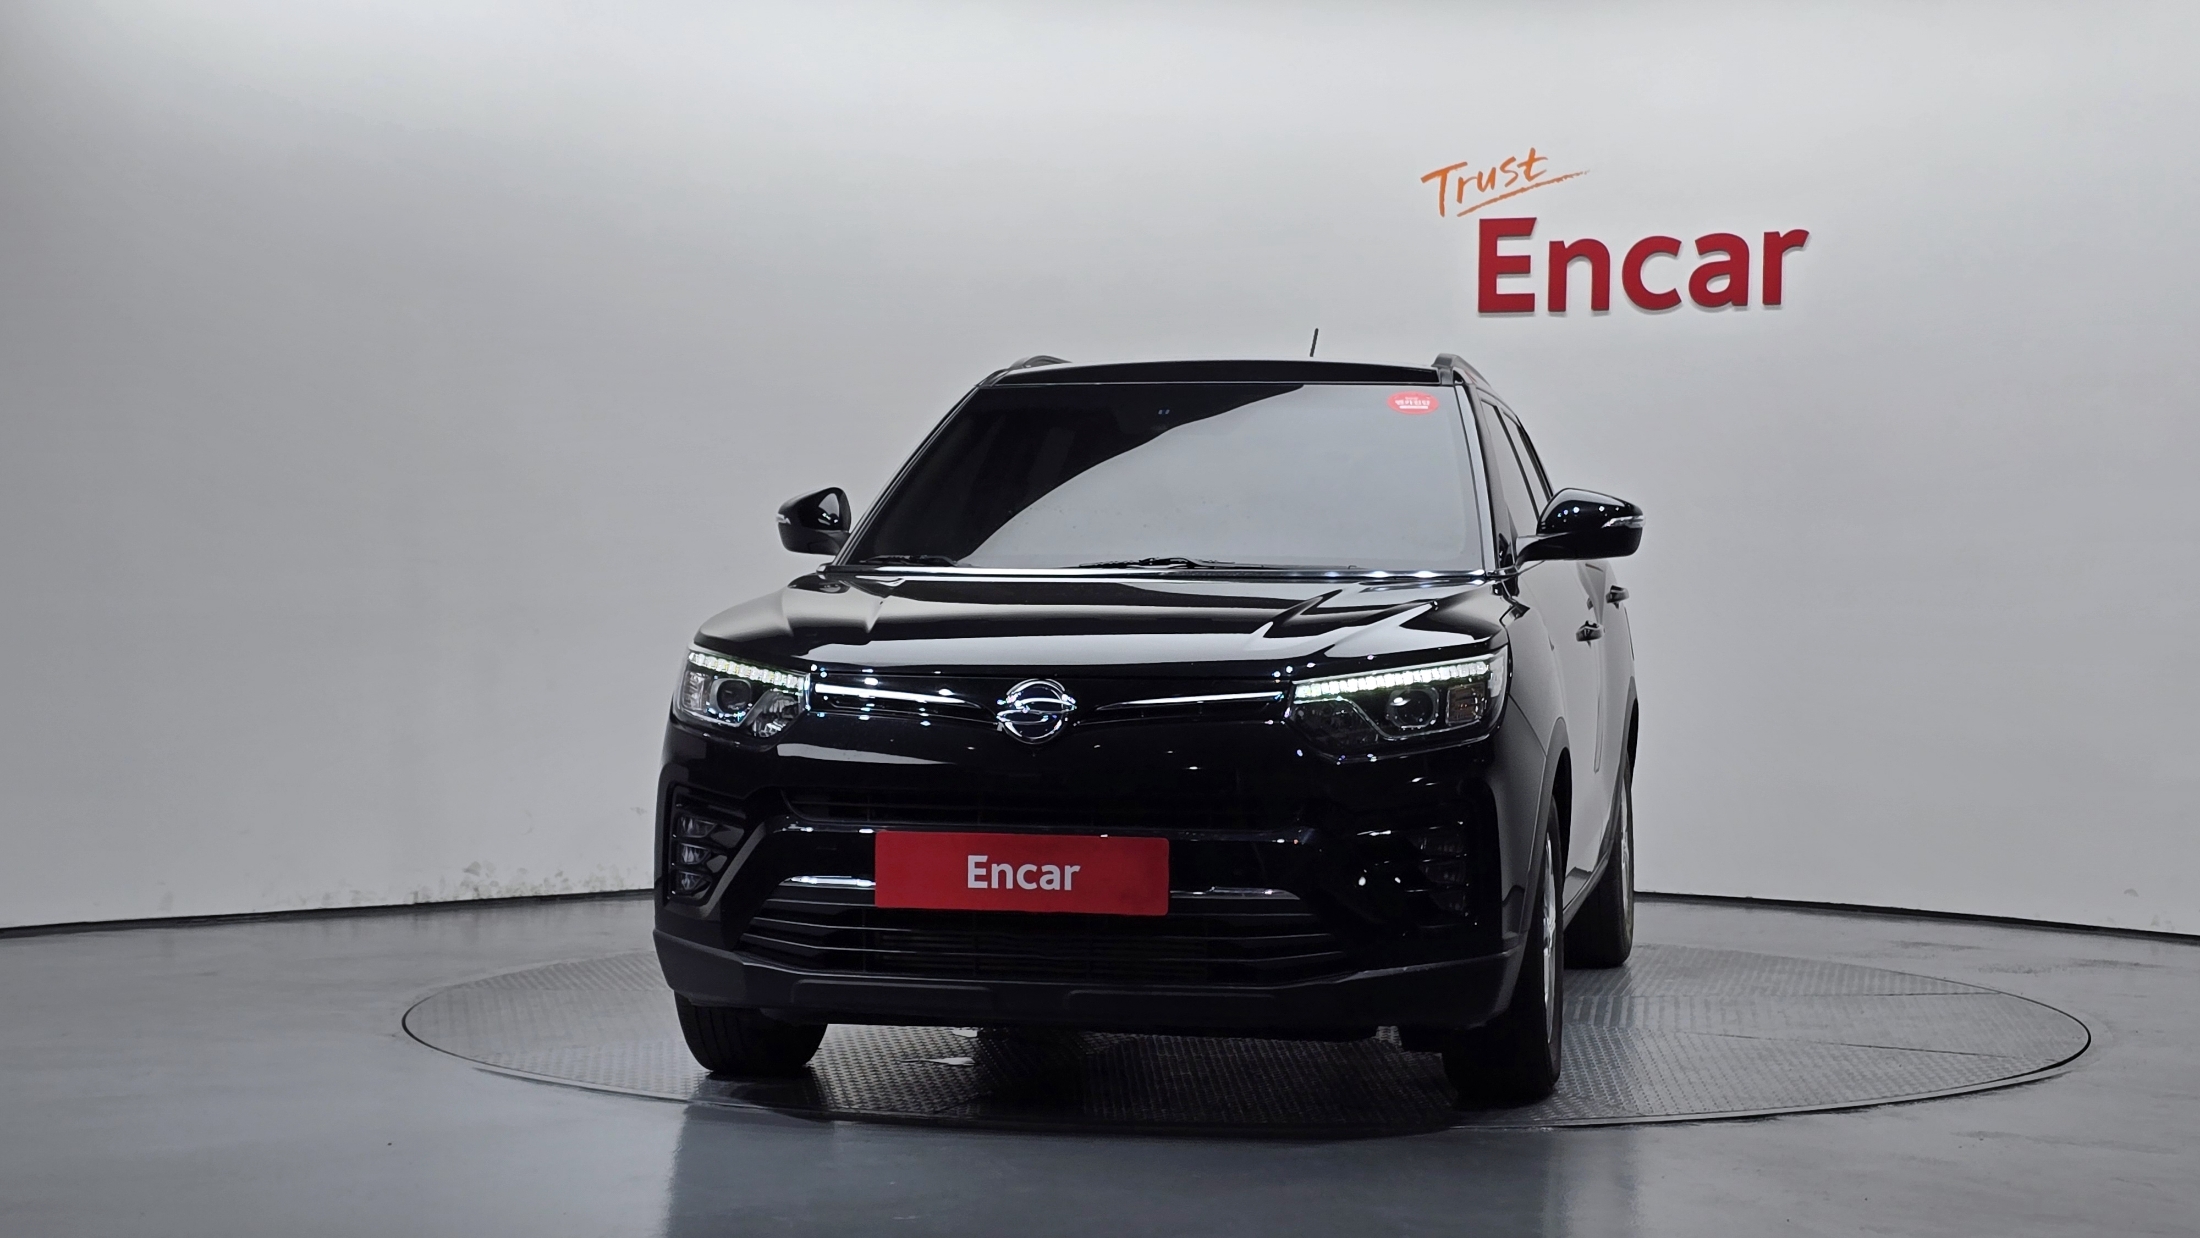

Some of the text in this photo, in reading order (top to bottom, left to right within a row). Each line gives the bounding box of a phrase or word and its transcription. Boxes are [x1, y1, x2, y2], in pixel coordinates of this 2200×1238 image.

[1420, 147, 1549, 217] Trust
[1477, 216, 1811, 313] Encar
[967, 854, 1081, 891] Encar
